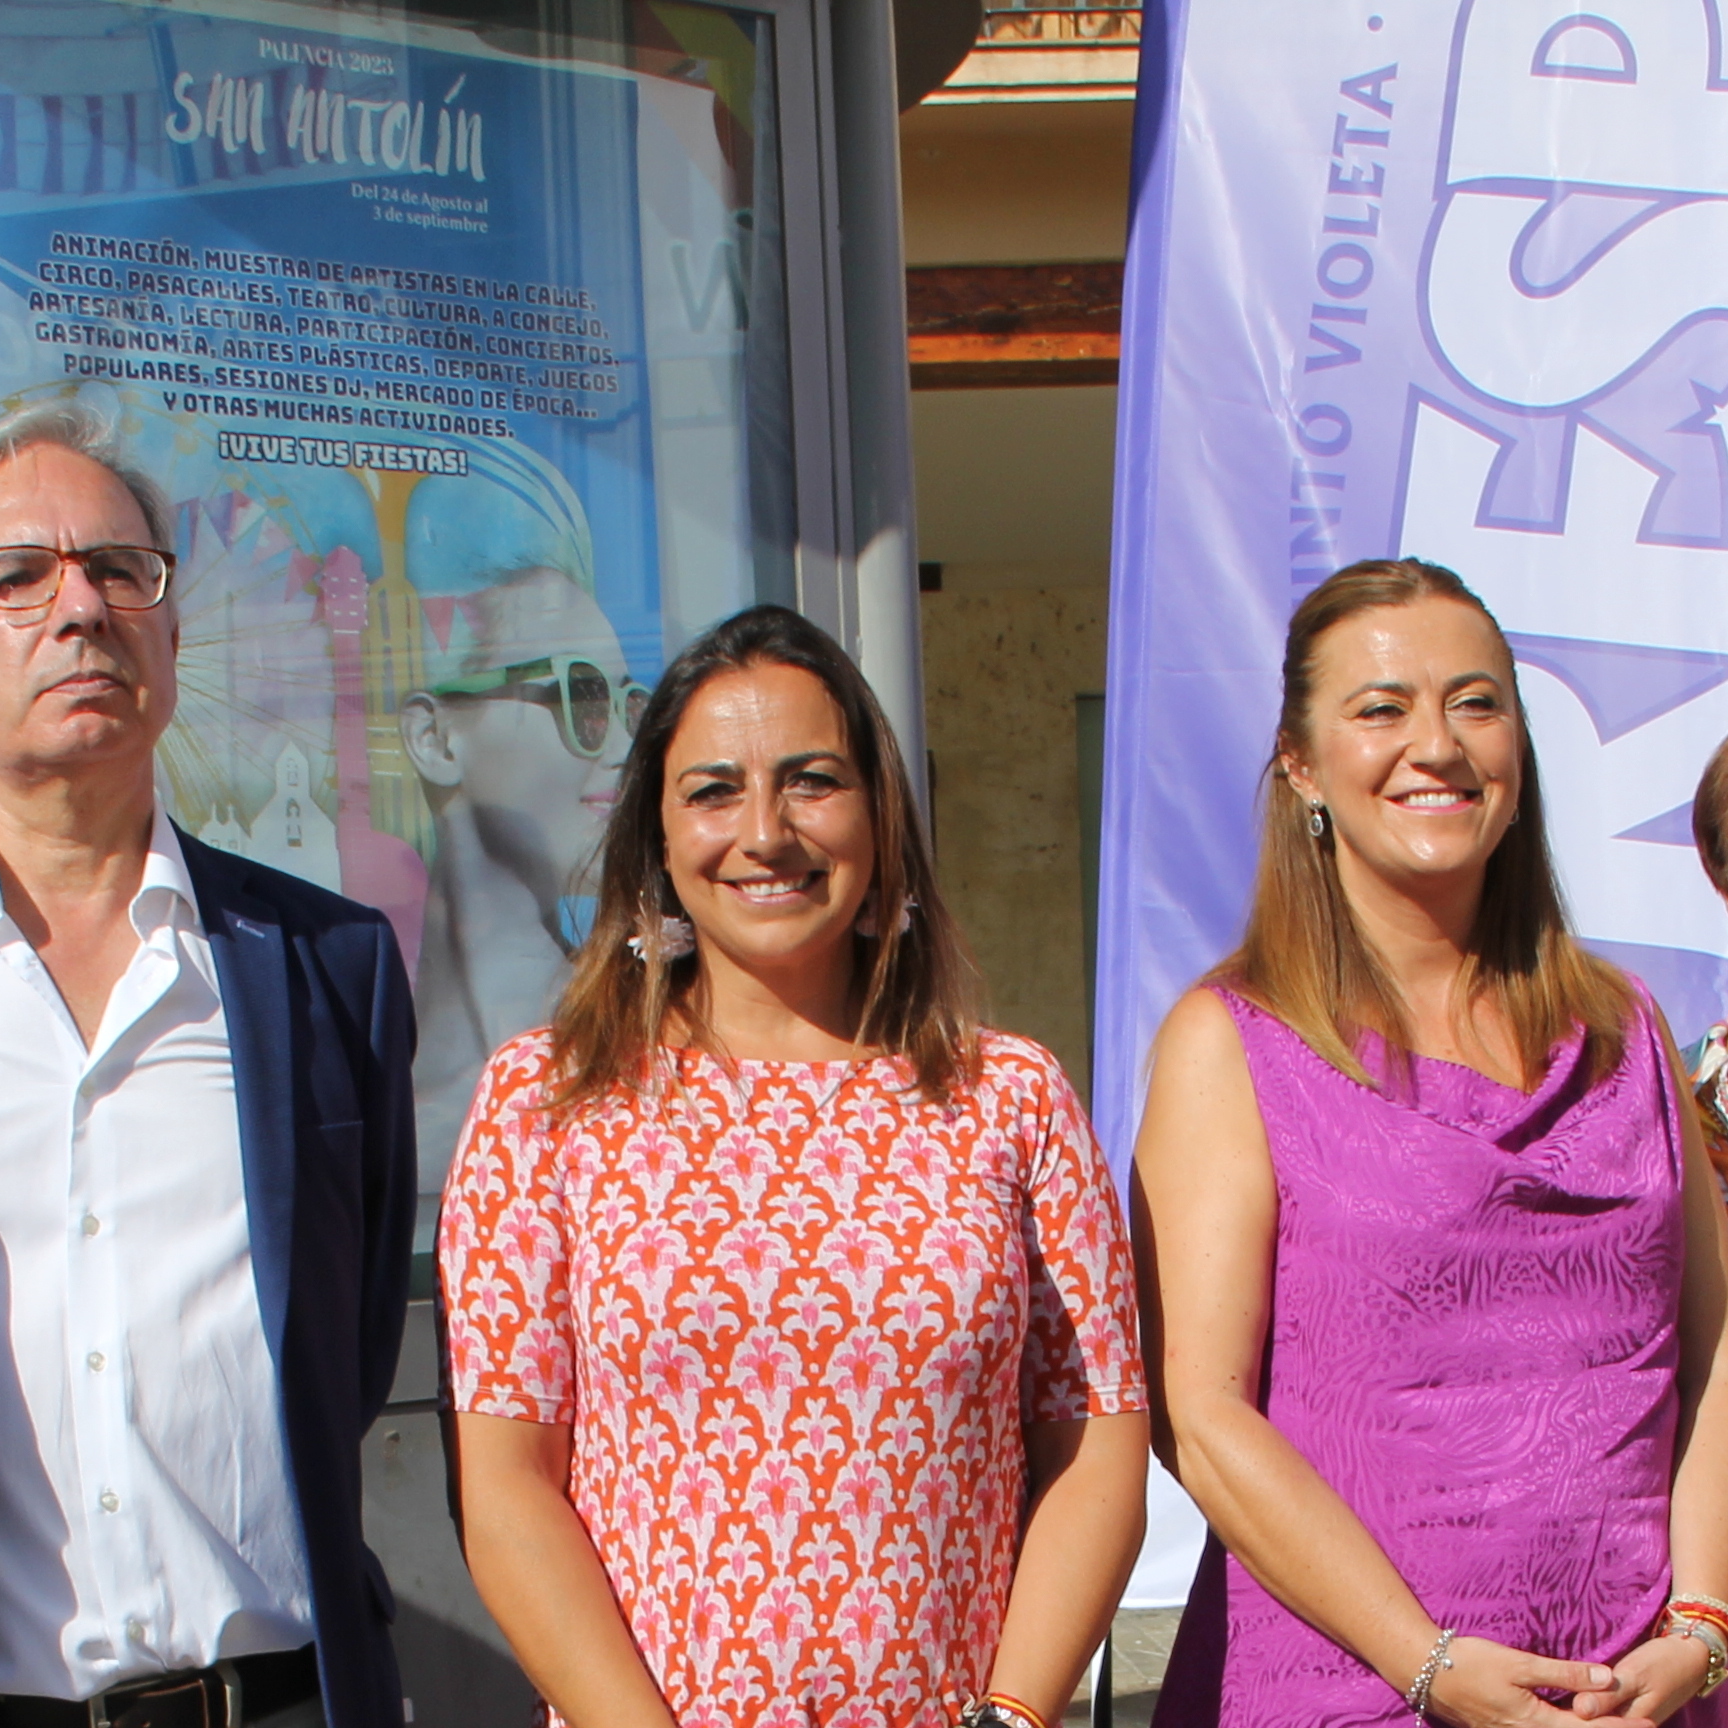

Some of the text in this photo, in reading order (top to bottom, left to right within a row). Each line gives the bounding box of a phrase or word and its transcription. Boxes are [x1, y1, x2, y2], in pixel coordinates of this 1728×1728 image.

[258, 38, 394, 75] PALENCIA 2023
[165, 71, 267, 155] SAN
[351, 183, 489, 214] Del 24 de Agosto al
[373, 206, 488, 233] 3 de septiembre
[39, 262, 610, 340] CIRCO, PASACALLES, TEATRO, CULTURA, A CONCEJO,
[52, 234, 597, 311] ANIMACIÓN, MUESTRA DE ARTISTAS EN LA CALLE,
[29, 291, 174, 325] ARTESANÍA,
[180, 306, 292, 336] LECTURA,
[297, 316, 482, 355] PARTICIPACIÓN,
[1290, 62, 1399, 600] NTO VIOLETA
[35, 322, 619, 393] GASTRONOMÍA, ARTES PLÁSTICAS, DEPORTE, JUEGOS
[64, 353, 210, 387] POPULARES,
[215, 367, 328, 395] SESIONES
[334, 377, 370, 400] DJ,
[376, 381, 475, 407] MERCADO
[480, 391, 507, 410] DE
[162, 391, 515, 437] Y OTRAS MUCHAS ACTIVIDADES.
[218, 431, 469, 476] ¡VIVE TUS FIESTAS!
